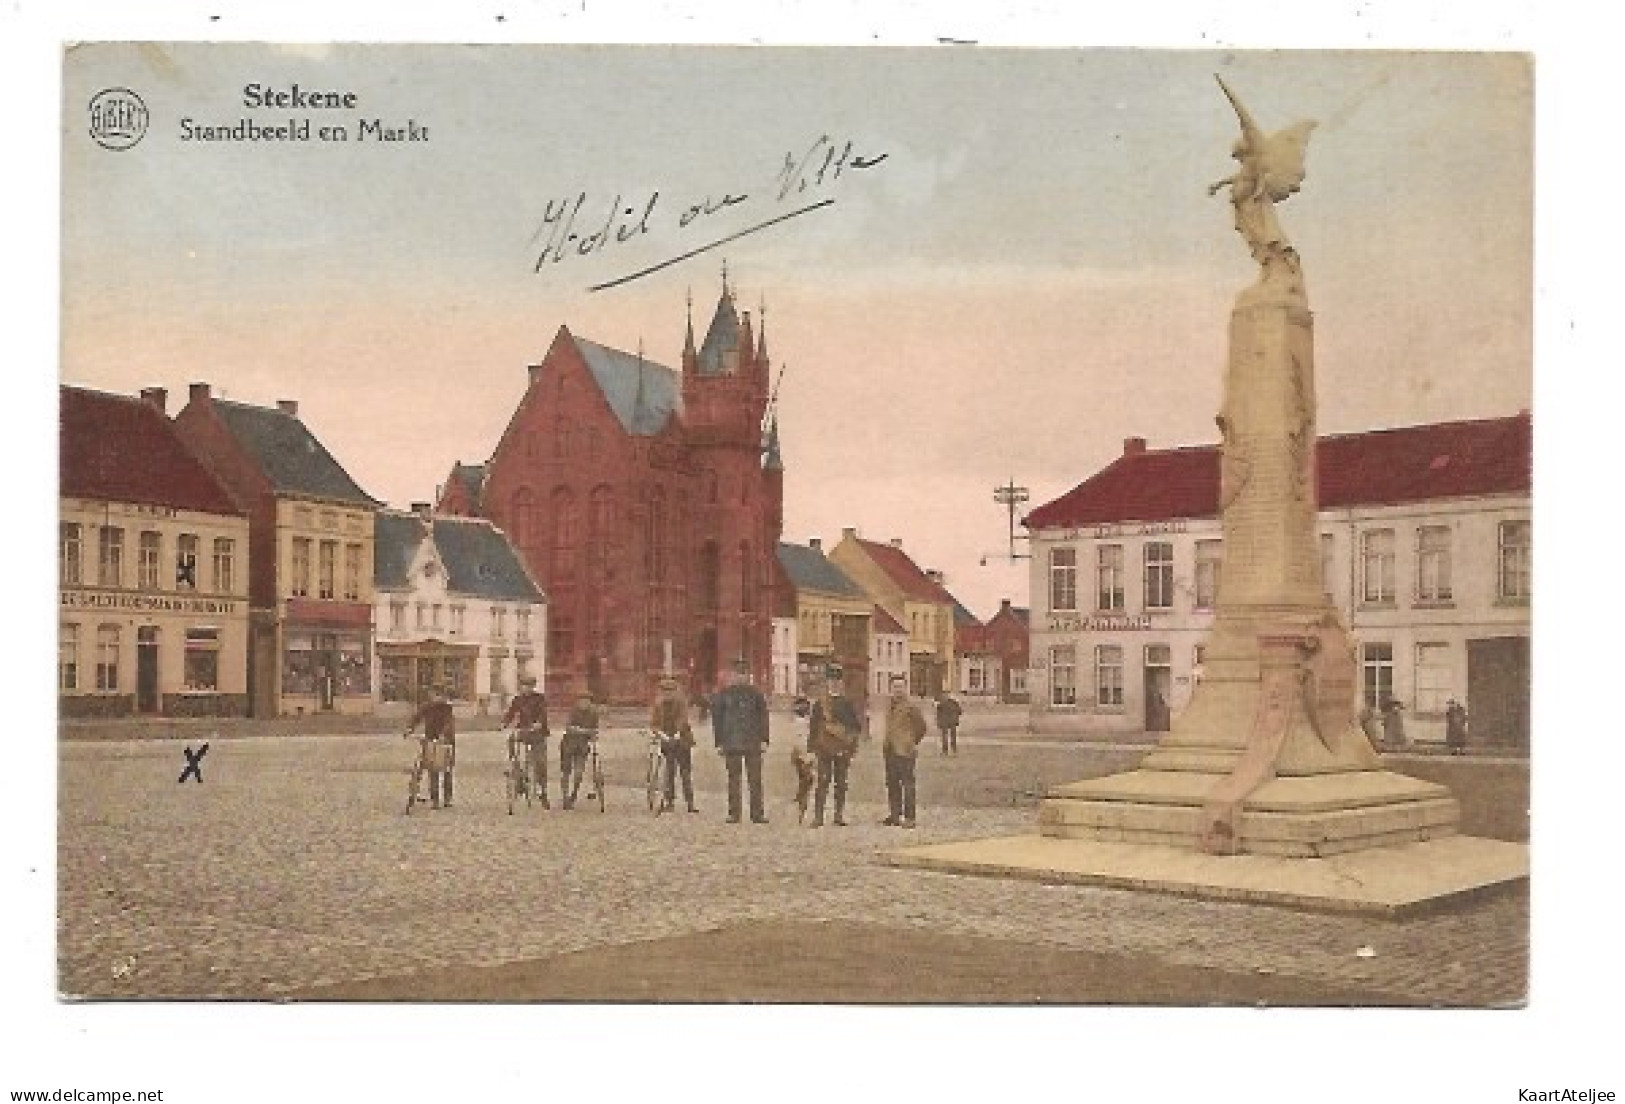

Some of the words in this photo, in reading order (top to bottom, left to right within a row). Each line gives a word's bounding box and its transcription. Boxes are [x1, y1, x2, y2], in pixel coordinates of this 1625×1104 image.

[242, 83, 358, 109] Stekene
[180, 117, 311, 142] Standbeeld
[318, 123, 348, 142] en
[356, 118, 430, 142] Markt
